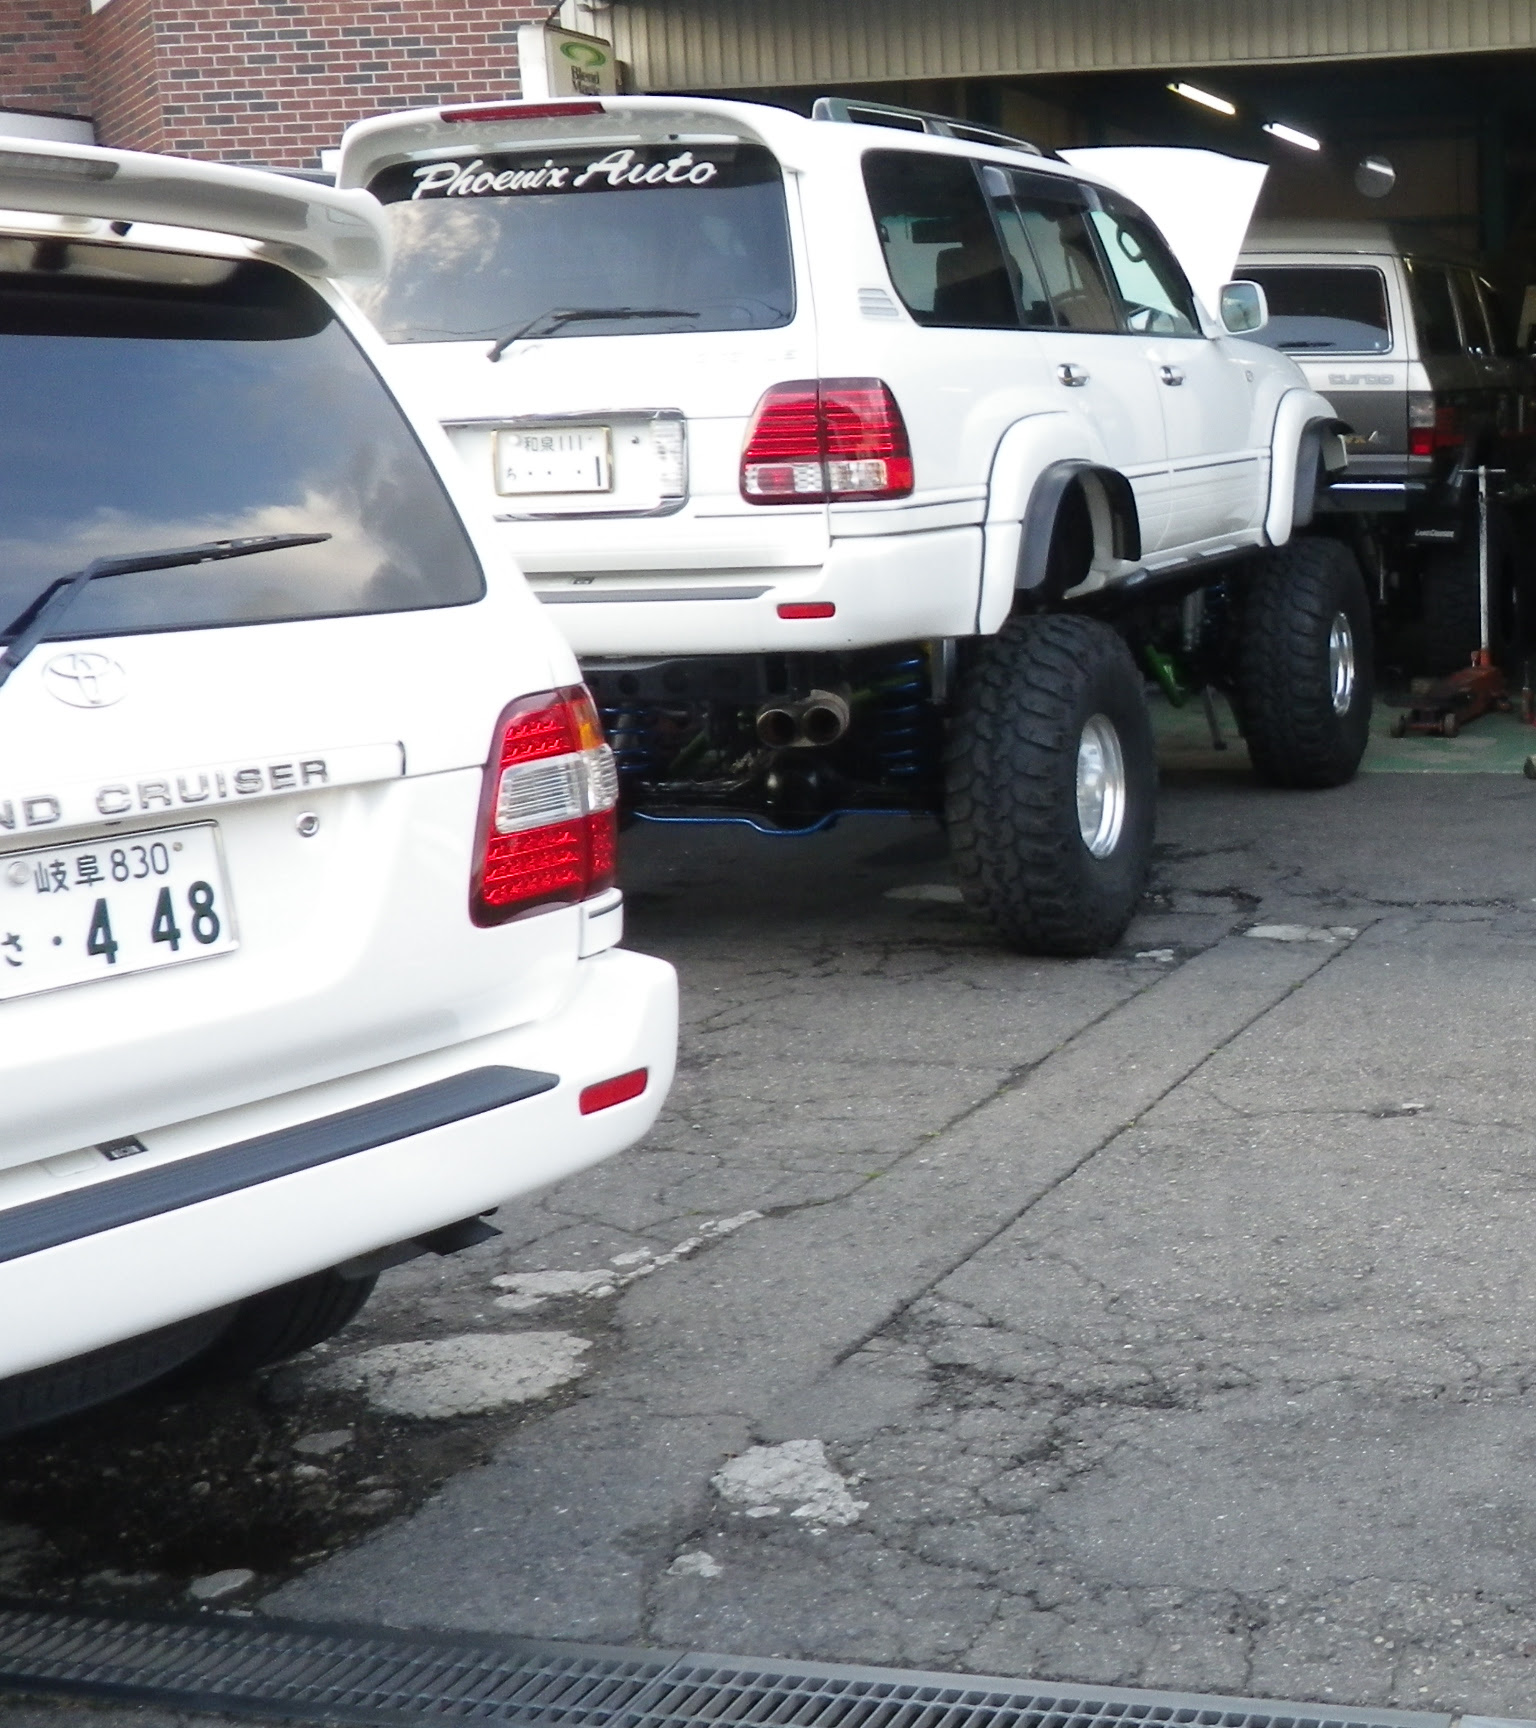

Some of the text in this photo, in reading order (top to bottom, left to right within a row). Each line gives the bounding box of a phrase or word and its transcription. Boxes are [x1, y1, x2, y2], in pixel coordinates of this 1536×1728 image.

[412, 149, 717, 200] Phoenix Auto
[96, 759, 329, 815] CRUISER
[33, 842, 170, 894] 岐阜 830
